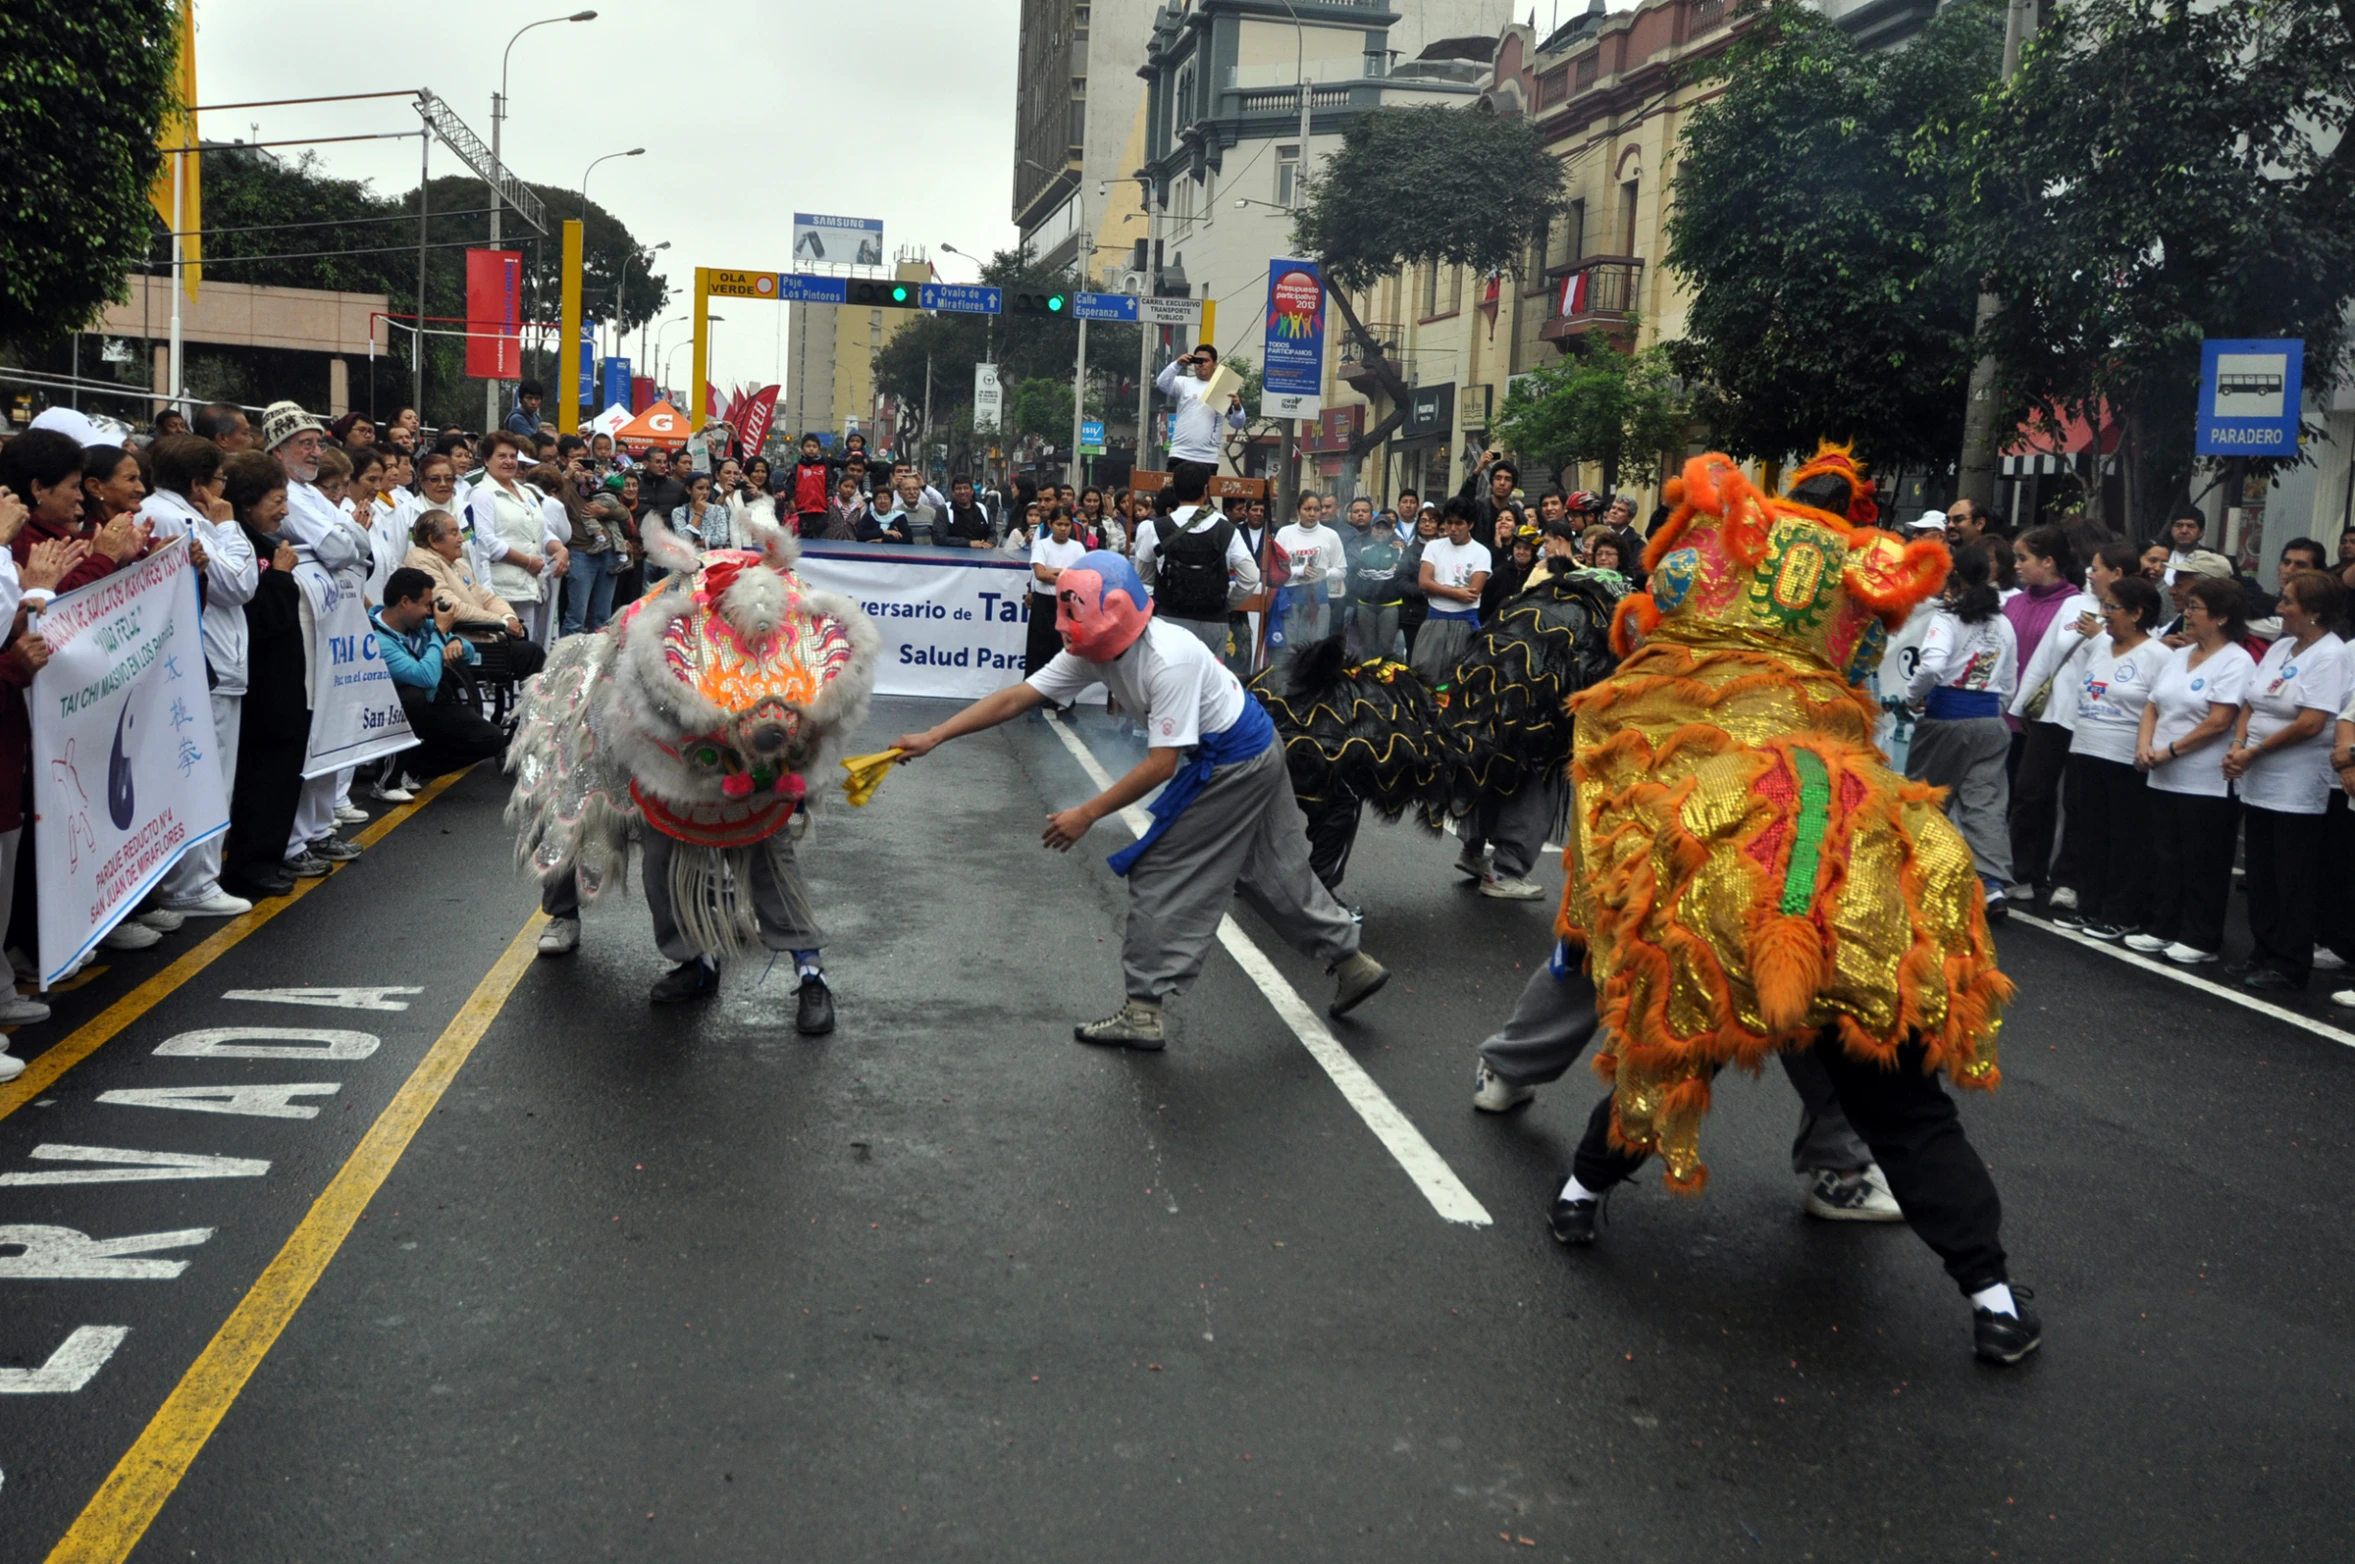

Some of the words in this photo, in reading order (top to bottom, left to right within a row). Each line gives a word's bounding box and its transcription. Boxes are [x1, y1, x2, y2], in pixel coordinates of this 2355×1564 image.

[812, 215, 865, 229] SAMSUNG
[720, 273, 746, 284] OLA
[711, 284, 755, 295] VERDE
[783, 288, 800, 299] Los
[803, 289, 840, 301] Pintores
[941, 286, 965, 298] Ovalo
[968, 288, 980, 299] de
[1277, 284, 1319, 295] Presupuesto
[1076, 294, 1097, 305] Calle
[1141, 298, 1163, 306] CARRIL
[1166, 300, 1200, 308] EXCLUSIVO
[1276, 292, 1316, 302] participativo
[937, 297, 984, 311] Miraflores
[1151, 306, 1192, 314] TRANSPORTE
[1296, 300, 1316, 309] 2013
[1076, 306, 1119, 319] Esperanza
[1268, 341, 1290, 349] TODOS
[1267, 347, 1313, 357] PARTICIPAMOS
[649, 413, 673, 431] G
[621, 437, 655, 445] GATORADE
[2211, 428, 2283, 444] PARADERO
[953, 607, 972, 621] de
[329, 633, 355, 665] TAI
[362, 633, 385, 661] C
[899, 644, 969, 668] Salud
[60, 693, 79, 719] TAI
[80, 681, 99, 710] CHI
[100, 662, 131, 700] MASIVO
[126, 654, 140, 677] EN
[139, 642, 155, 669] LOS
[353, 670, 361, 682] el
[362, 707, 384, 730] San
[96, 850, 124, 893] PARQUE
[123, 818, 159, 862] REDUCTO
[90, 897, 106, 925] SAN
[106, 874, 128, 908] JUAN
[125, 863, 139, 887] DE
[137, 821, 185, 875] MIRAFLORES
